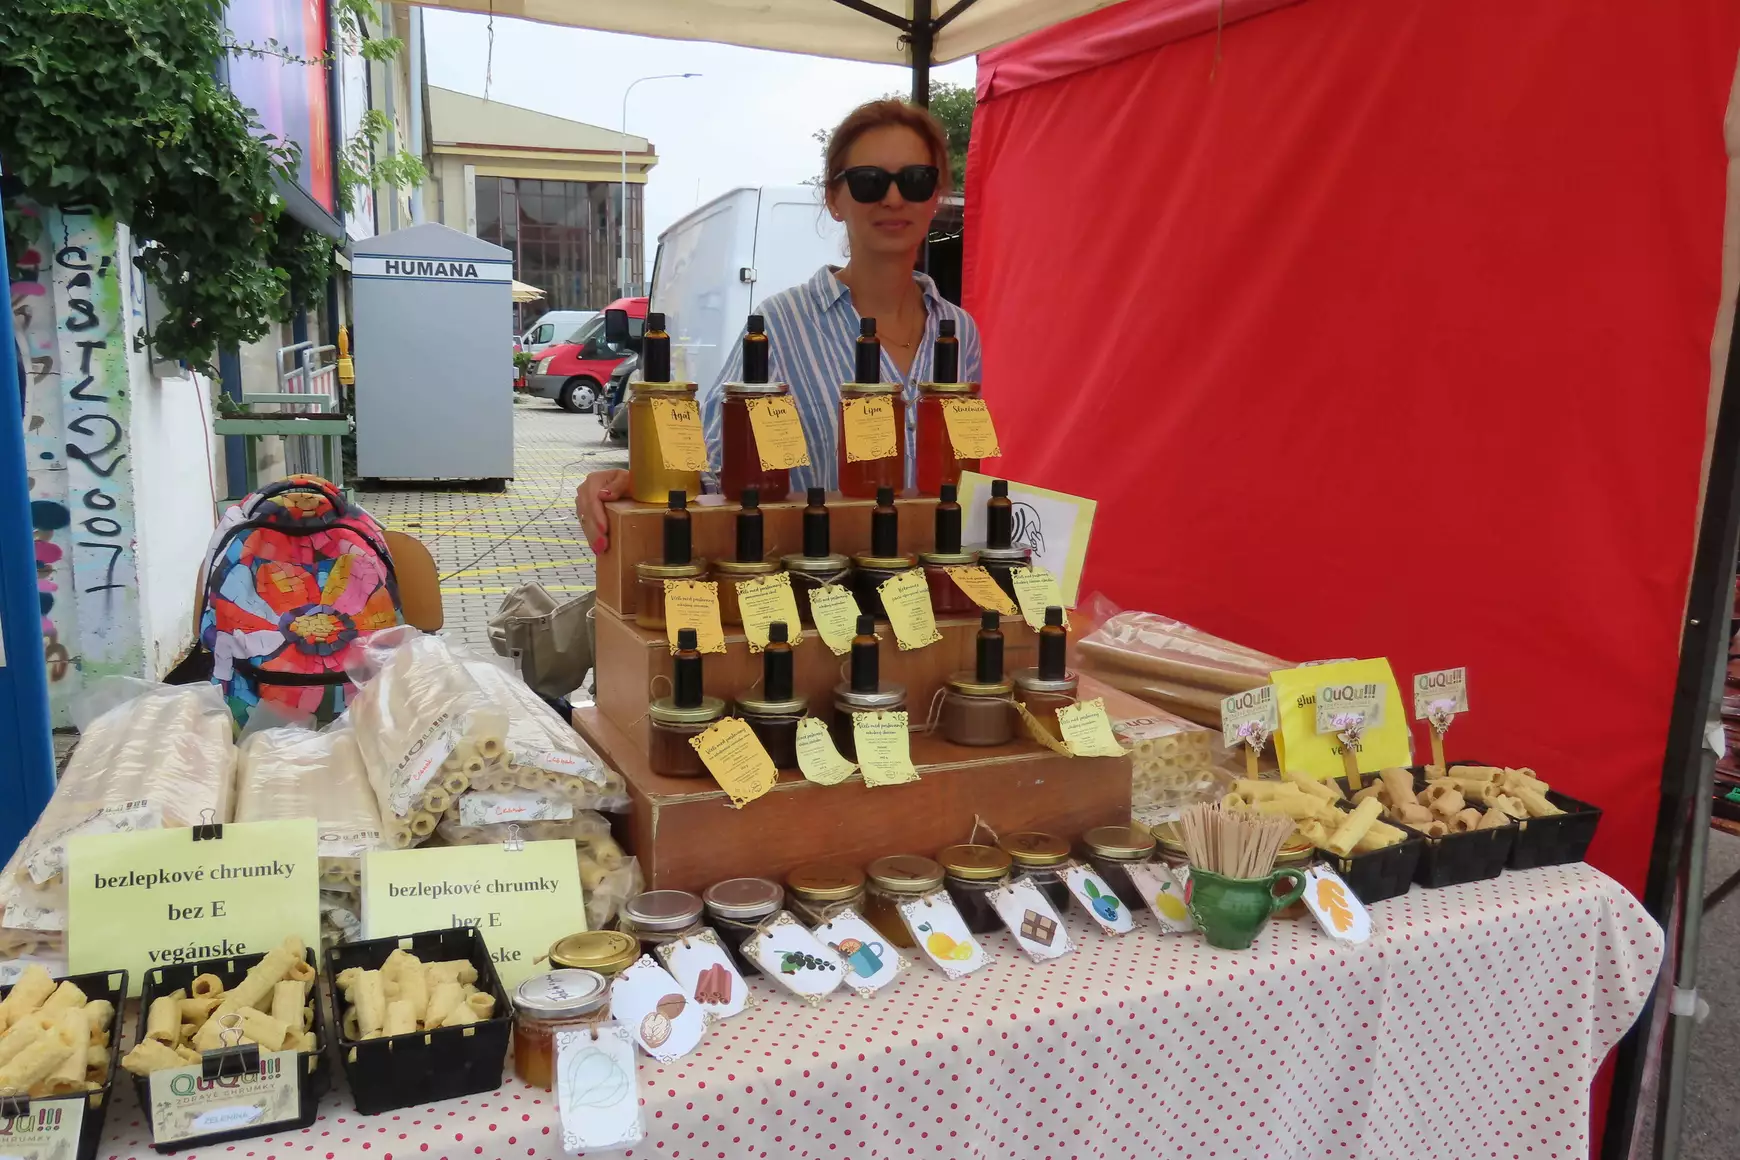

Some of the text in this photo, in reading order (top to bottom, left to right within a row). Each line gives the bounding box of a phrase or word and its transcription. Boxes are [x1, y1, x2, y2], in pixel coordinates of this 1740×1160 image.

[385, 260, 479, 278] HUMANA
[671, 409, 691, 422] Agát
[766, 406, 787, 418] Lipa
[1418, 669, 1462, 690] QuQu!!!
[1226, 686, 1271, 714] QuQu!!!
[1297, 695, 1316, 708] glut
[1323, 684, 1377, 703] QuQu!!!
[1331, 744, 1362, 756] ven
[95, 860, 296, 890] bezlepkové chrumky
[389, 876, 560, 899] bezlepkové chrumky
[168, 900, 227, 921] bez E
[452, 912, 502, 929] bez E
[149, 939, 247, 964] vegánske
[0, 1135, 52, 1143] HRUMKY
